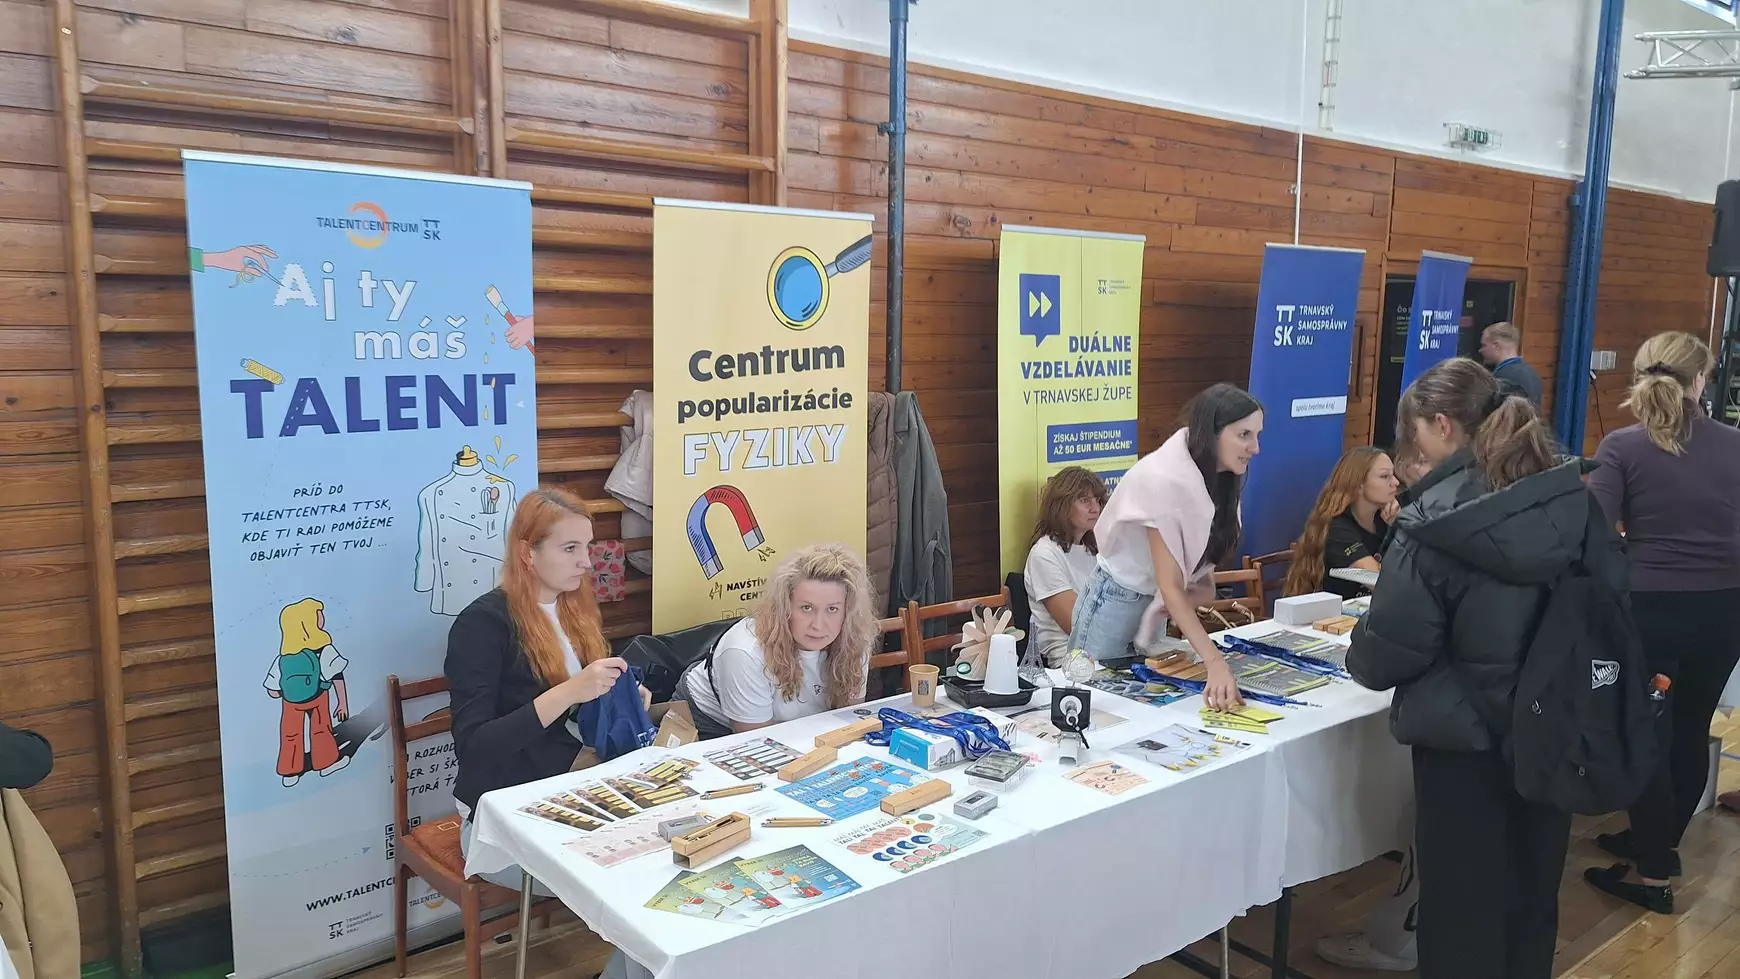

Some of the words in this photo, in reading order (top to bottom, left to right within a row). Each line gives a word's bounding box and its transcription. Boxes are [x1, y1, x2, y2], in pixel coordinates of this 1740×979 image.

[316, 217, 419, 233] TALENTCENTRUM
[423, 229, 441, 240] SK
[272, 260, 337, 322] Aj
[357, 270, 418, 322] ty
[1276, 304, 1296, 322] TT
[1300, 304, 1334, 316] TRNAVSKÝ
[1298, 318, 1348, 330] SAMOSPRÁVNY
[354, 315, 468, 360] máš
[1068, 331, 1132, 353] DUÁLNE
[1274, 325, 1294, 346] SK
[1296, 335, 1314, 346] KRAJ
[1419, 330, 1431, 350] SK
[688, 344, 845, 382] Centrum
[1020, 356, 1132, 380] VZDELÁVANIE
[1023, 390, 1032, 405] V
[1033, 387, 1100, 404] TRNAVSKEJ
[1102, 383, 1132, 401] ŽUPE
[229, 373, 516, 440] TALENT
[678, 386, 853, 424] popularizácie
[1054, 432, 1078, 444] ZÍSKAJ
[1080, 430, 1122, 440] ŠTIPENDIUM
[684, 423, 845, 476] FYZIKY
[1054, 444, 1064, 455] AŽ
[1065, 446, 1074, 454] 50
[1077, 444, 1092, 453] EUR
[293, 482, 323, 498] PRÍĎ
[328, 484, 344, 495] DO
[242, 503, 346, 522] TALENTCENTRA
[352, 499, 392, 512] TTSK,
[242, 530, 268, 543] KDE
[276, 528, 290, 539] TI
[296, 524, 326, 537] RADI
[331, 516, 394, 532] POMÔŽEME
[250, 543, 304, 562] OBJAVIŤ
[310, 542, 336, 554] TEN
[342, 537, 374, 550] TVOJ
[430, 764, 440, 773] SI
[444, 757, 460, 770] ŠK
[329, 928, 344, 940] SK
